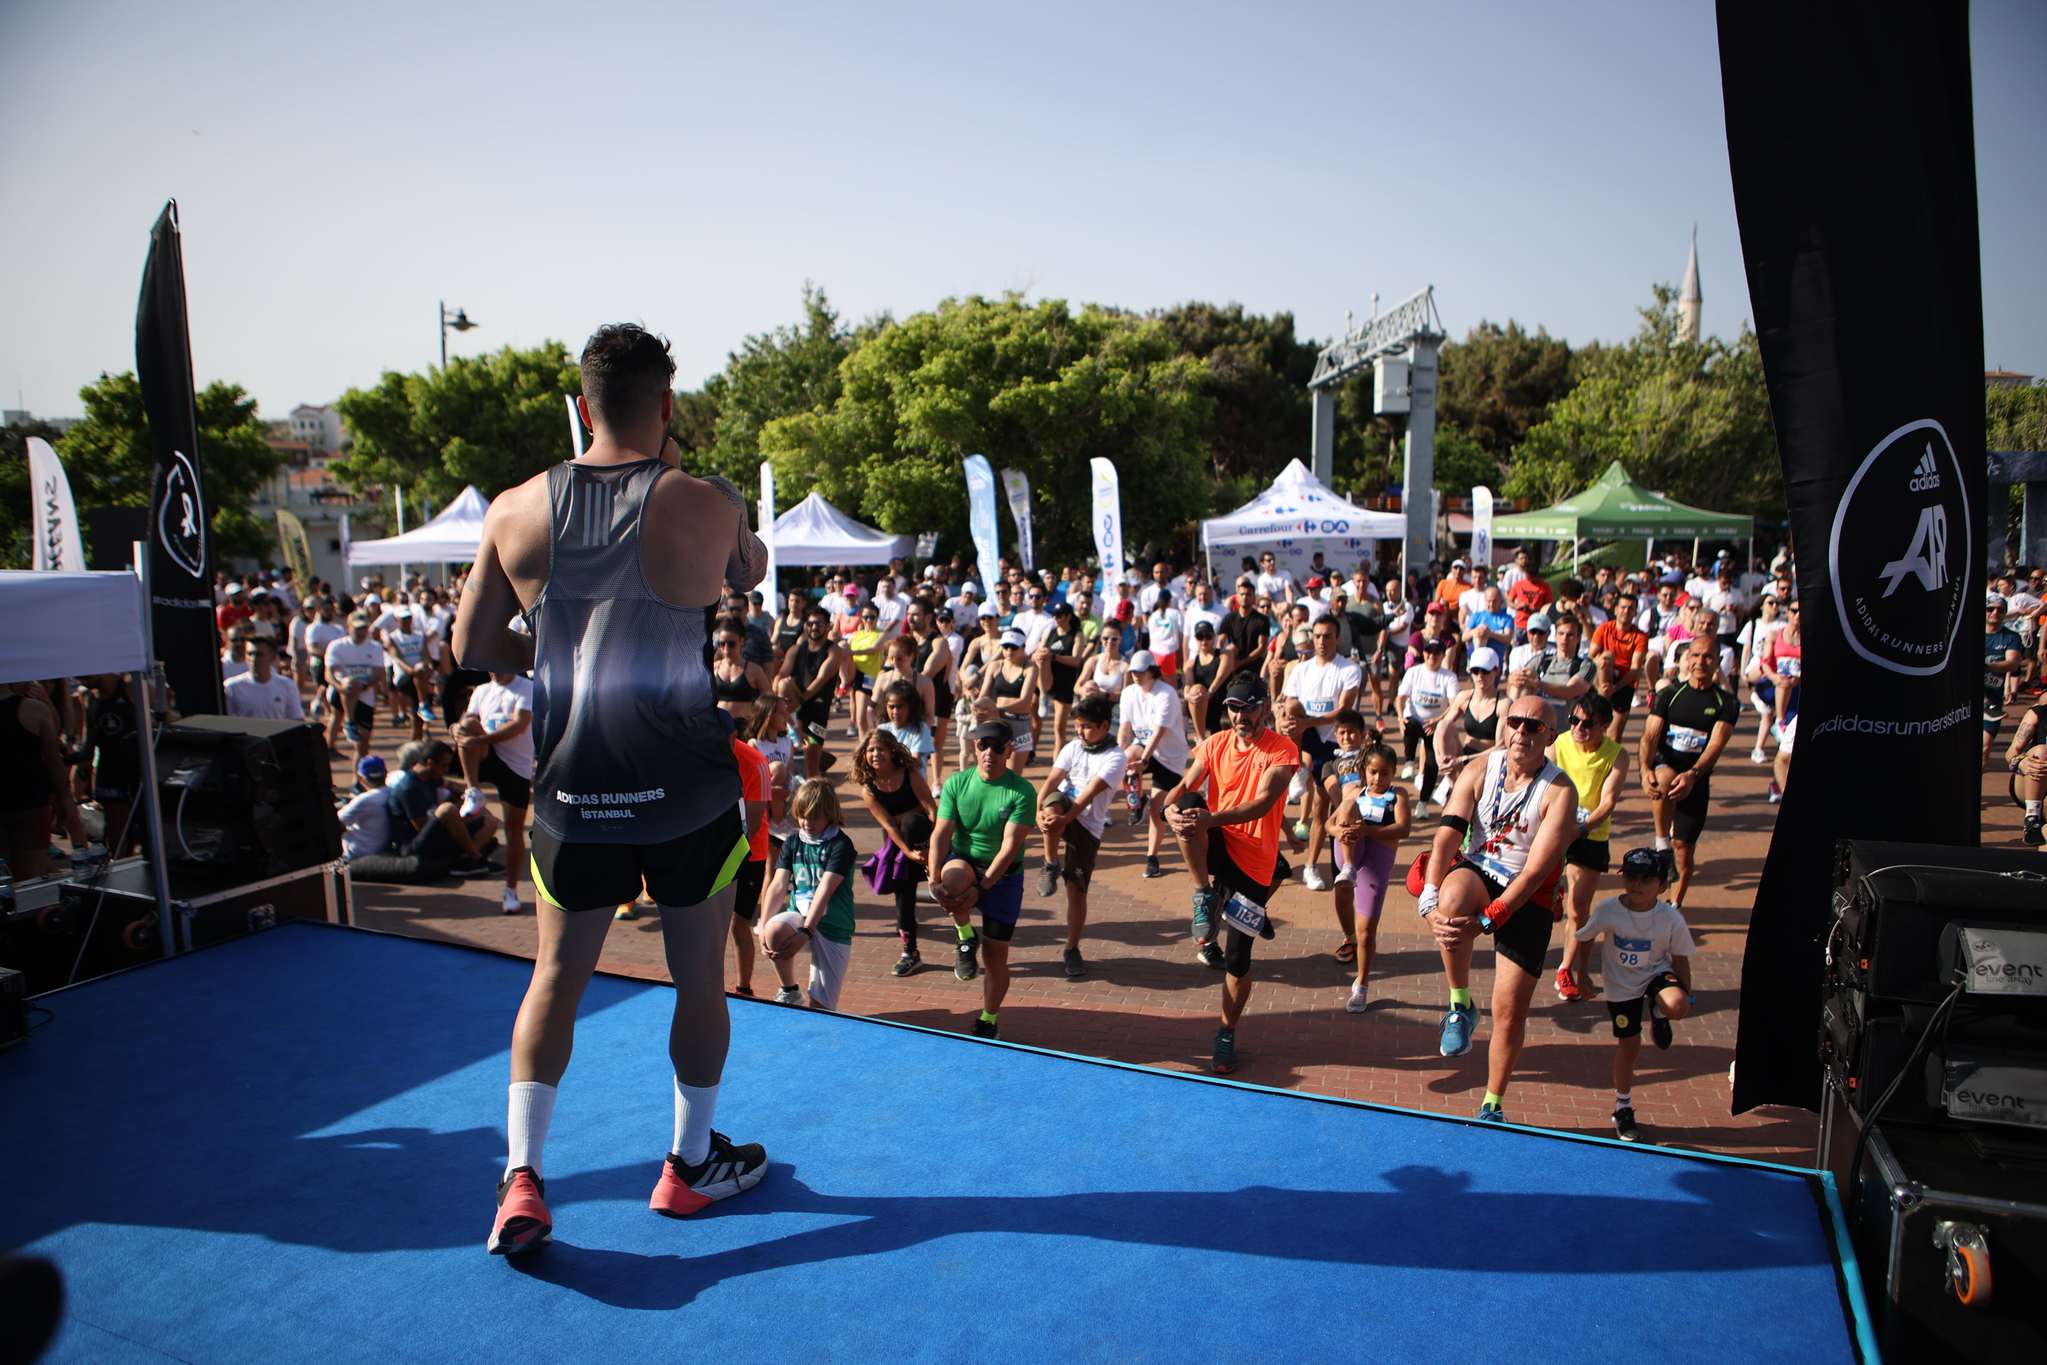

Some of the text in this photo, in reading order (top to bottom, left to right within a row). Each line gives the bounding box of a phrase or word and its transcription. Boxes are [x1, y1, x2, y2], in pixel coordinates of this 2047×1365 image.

[1909, 472, 1940, 492] adidas
[1239, 523, 1293, 536] Carrefour
[1856, 597, 1943, 655] ADIDAS RUNNERS
[557, 788, 665, 805] ADIDAS RUNNERS
[1235, 906, 1262, 928] 1134
[1619, 952, 1638, 966] 98
[1975, 963, 2043, 977] event
[1957, 1090, 2025, 1111] event
